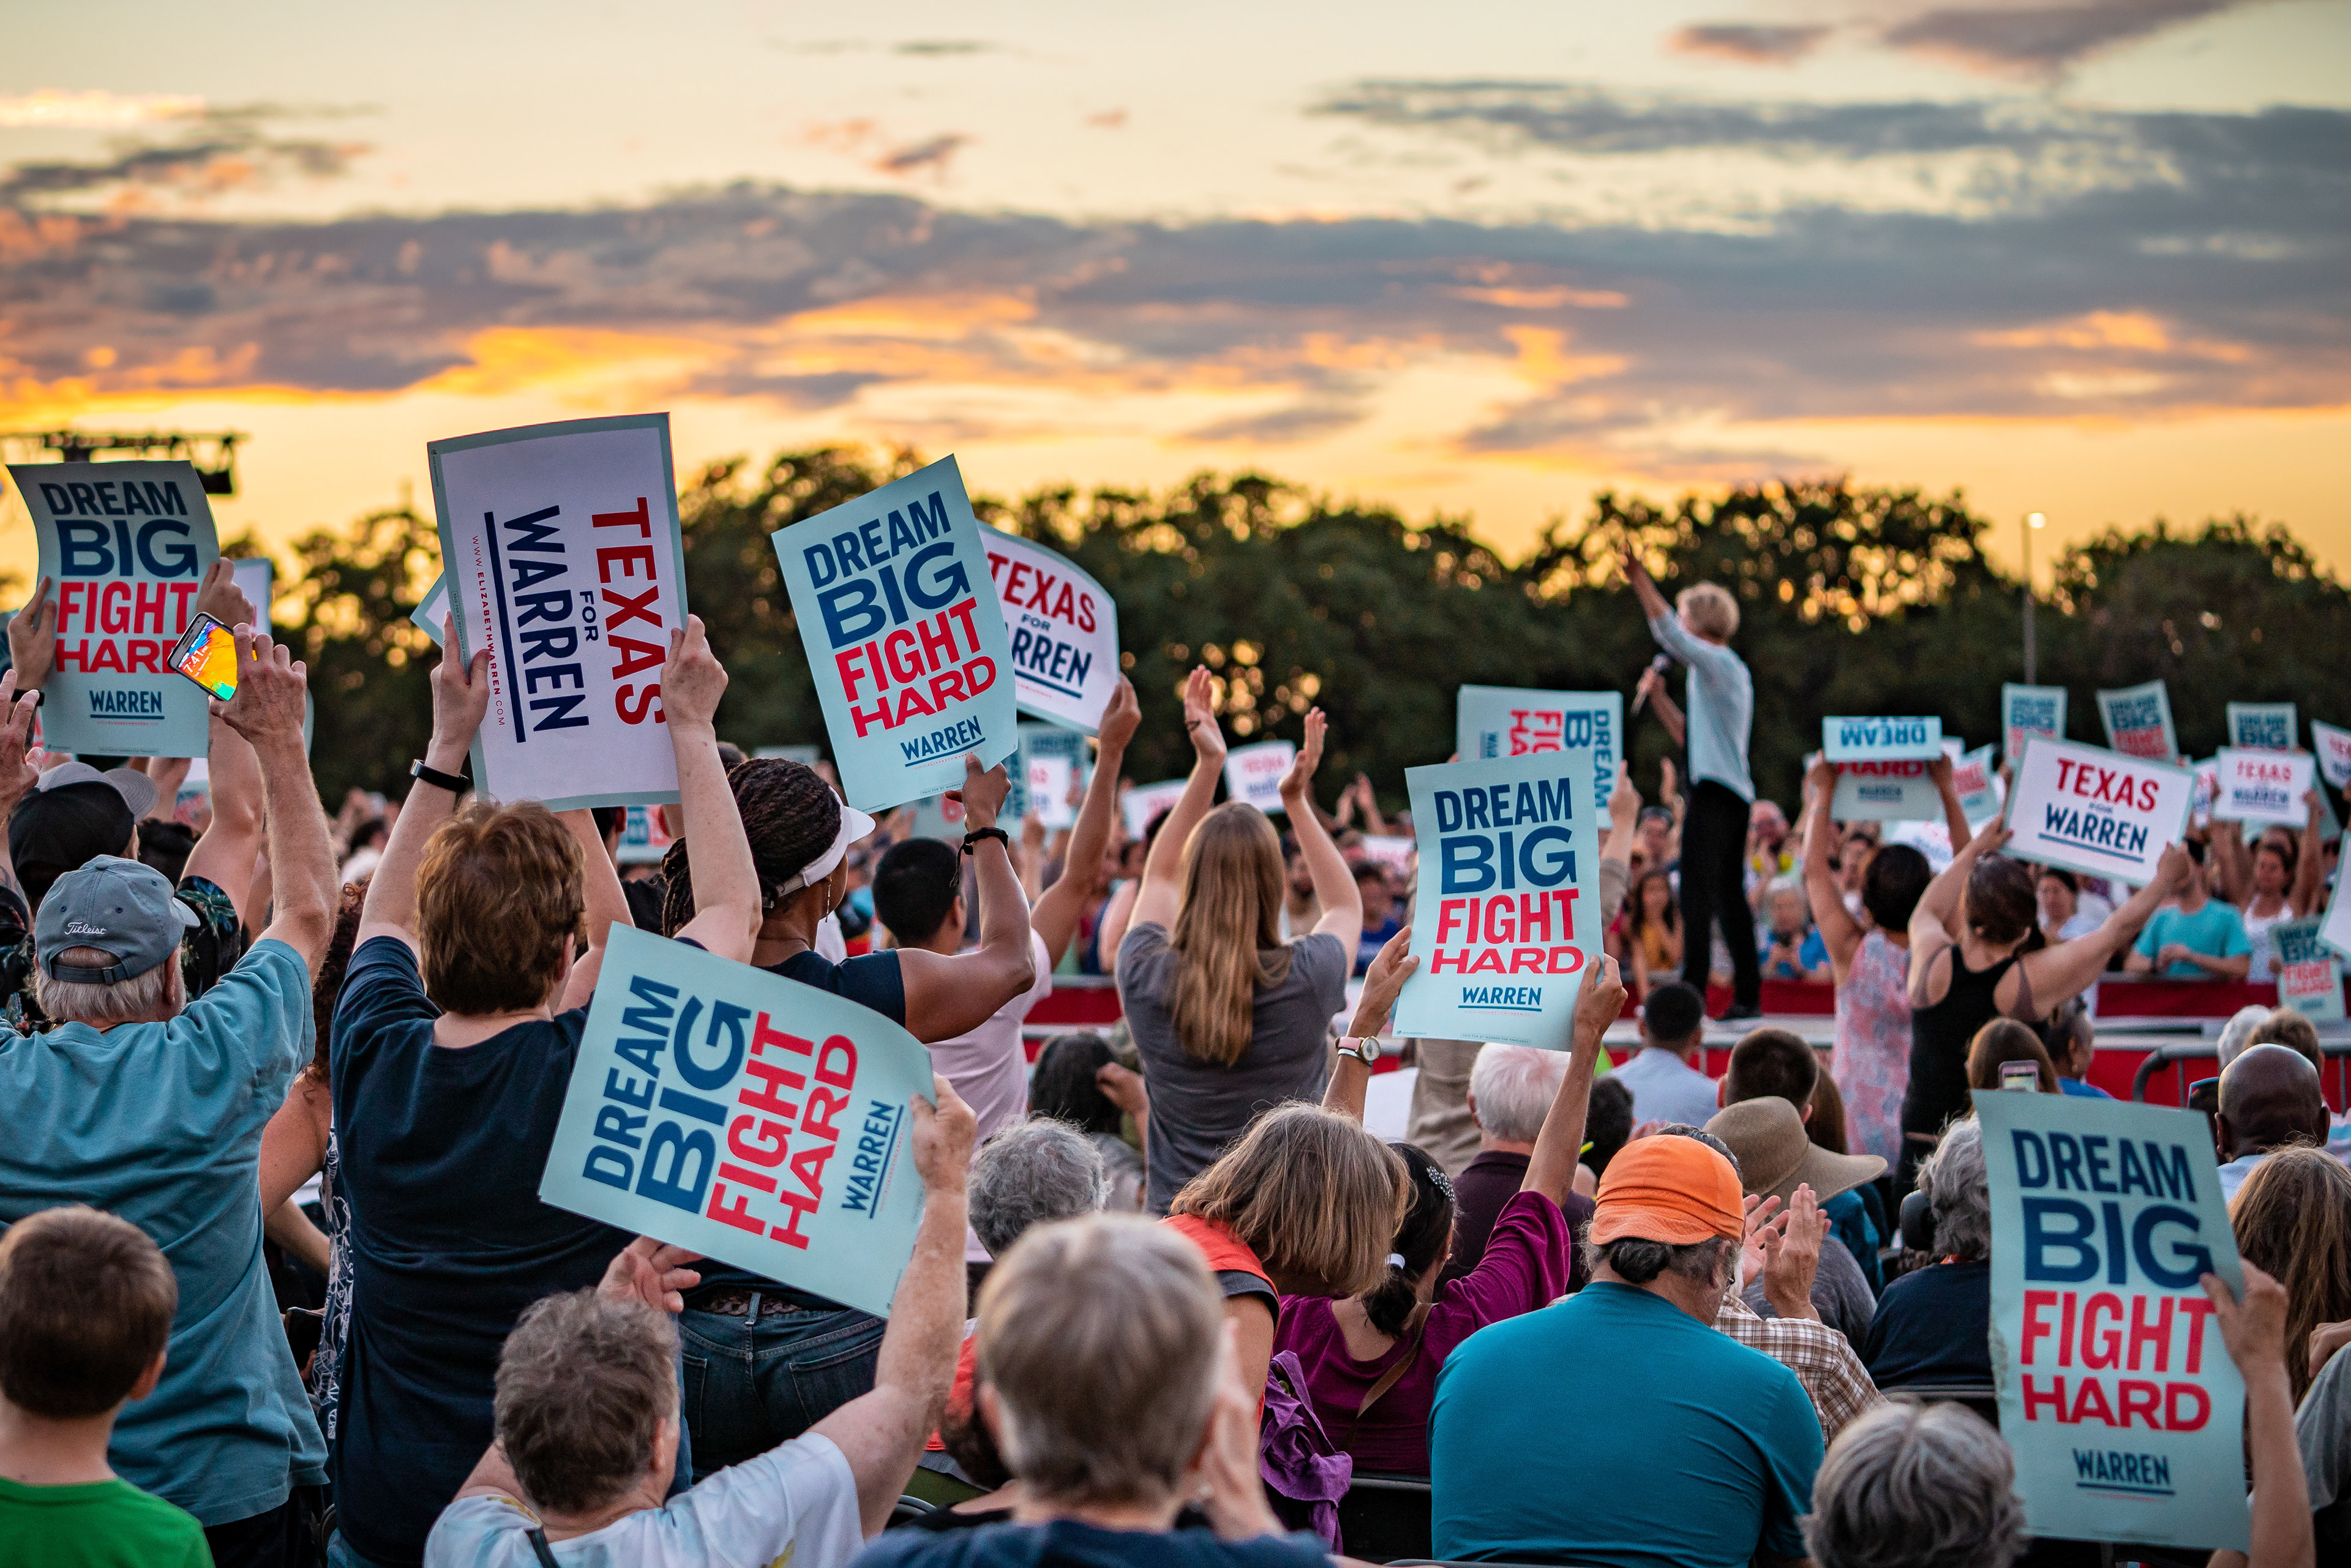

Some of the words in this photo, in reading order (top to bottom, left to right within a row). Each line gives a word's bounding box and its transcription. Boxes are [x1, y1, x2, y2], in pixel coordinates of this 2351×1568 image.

[39, 481, 188, 516] DREAM
[55, 519, 198, 578] BIG
[803, 490, 952, 590] DREAM
[56, 580, 199, 635] FIGHT
[503, 505, 590, 732] WARREN
[579, 589, 599, 642] FOR
[591, 497, 667, 726] TEXAS
[817, 541, 971, 650] BIG
[987, 551, 1097, 634] TEXAS
[1021, 613, 1051, 631] FOR
[183, 650, 204, 673] 7:41
[471, 535, 506, 727] WWW.ELIZABETHWARREN.COM
[834, 596, 981, 702] FIGHT
[1005, 621, 1092, 687] RREN
[89, 689, 162, 714] WARREN
[850, 656, 997, 738] HARD
[900, 715, 983, 761] WARREN
[1509, 708, 1530, 756] HA
[1594, 709, 1613, 808] DREAM
[1841, 722, 1927, 746] DREAM
[1434, 778, 1572, 833] DREAM
[2057, 757, 2160, 813] TEXAS
[2046, 802, 2148, 853] WARREN
[1440, 825, 1577, 894] BIG
[64, 922, 107, 935] Titleist
[1436, 888, 1579, 944] FIGHT
[1430, 945, 1584, 974] HARD
[1462, 986, 1542, 1006] WARREN
[582, 974, 680, 1191] DREAM
[635, 995, 752, 1215] BIG
[705, 1010, 816, 1236] FIGHT
[769, 1033, 858, 1251] HARD
[841, 1100, 896, 1212] WARREN
[2012, 1128, 2197, 1202] DREAM
[2020, 1196, 2214, 1289] BIG
[2020, 1289, 2220, 1375] FIGHT
[2021, 1373, 2211, 1433] HARD
[2072, 1447, 2171, 1487] WARREN
